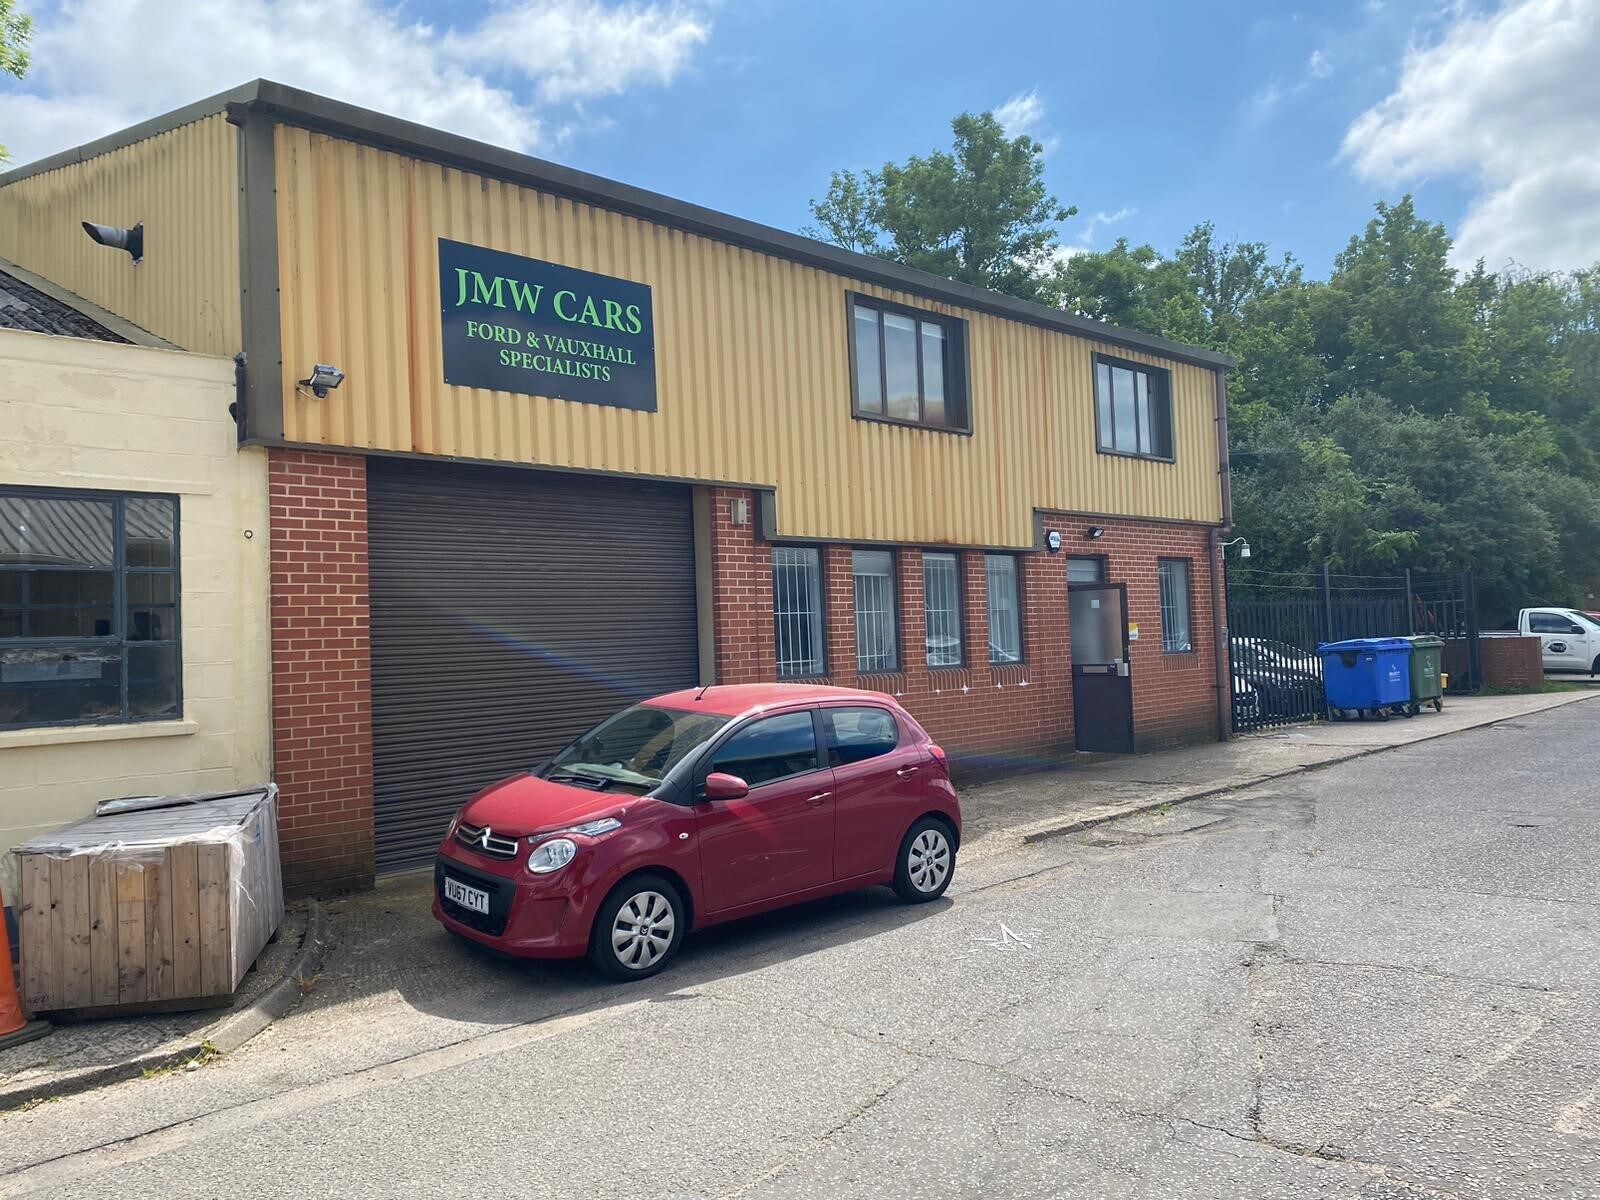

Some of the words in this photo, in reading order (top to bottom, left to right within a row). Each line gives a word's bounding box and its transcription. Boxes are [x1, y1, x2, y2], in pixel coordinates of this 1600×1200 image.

[455, 268, 544, 314] JMW
[553, 290, 643, 335] CARS
[466, 320, 521, 345] FORD
[526, 331, 541, 349] &
[543, 334, 637, 365] VAUXHALL
[499, 349, 611, 382] SPECIALISTS
[468, 890, 485, 910] CYT
